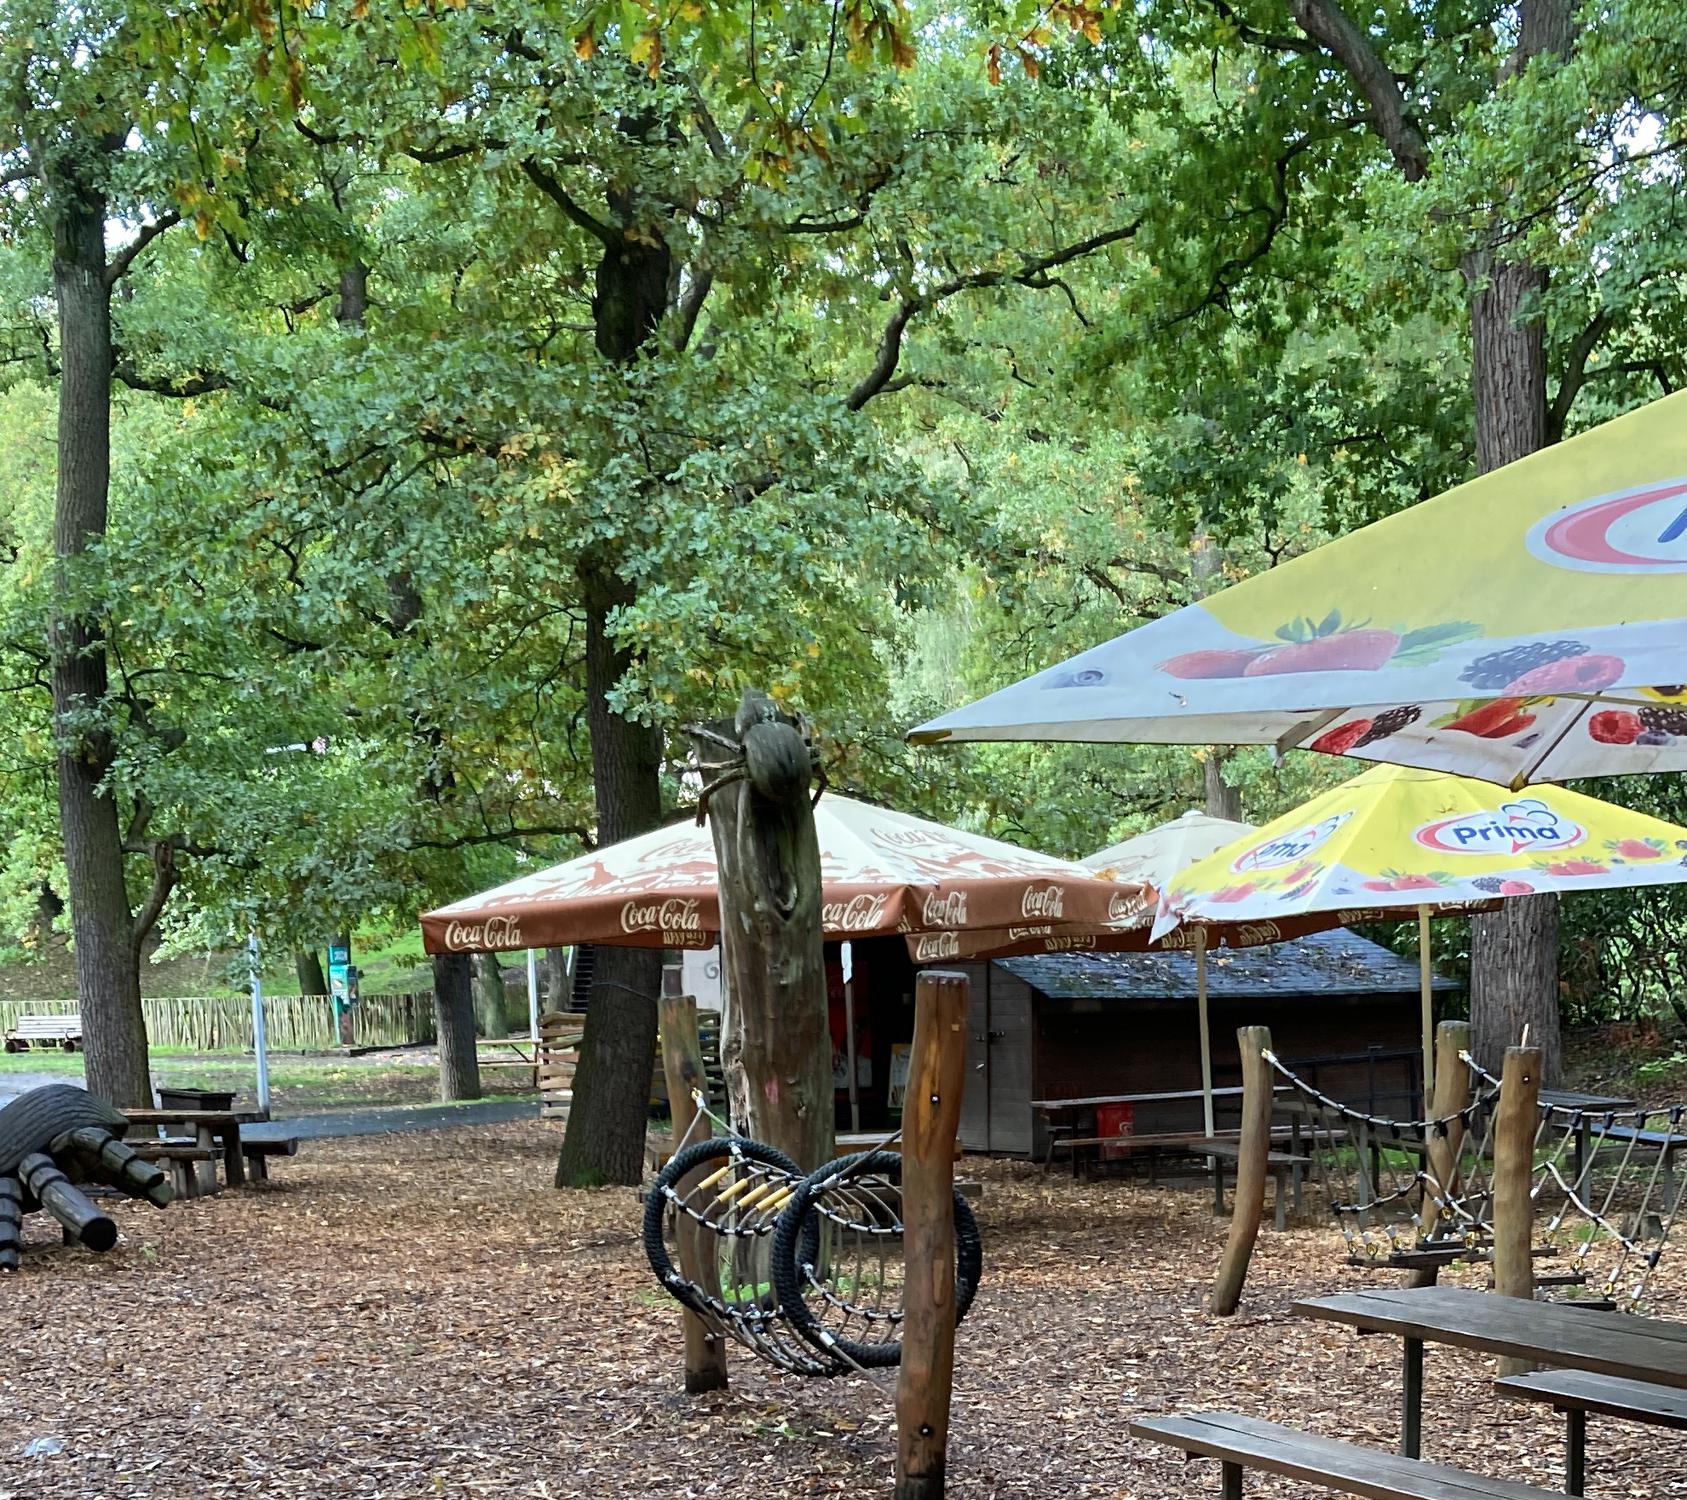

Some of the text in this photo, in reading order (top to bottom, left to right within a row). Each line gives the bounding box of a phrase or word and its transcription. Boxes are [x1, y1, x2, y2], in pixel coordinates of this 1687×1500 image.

[1452, 820, 1561, 845] Prima
[620, 898, 702, 934] Coca-Cola
[822, 893, 889, 932] ca-Cola
[922, 890, 968, 926] Coca-Cola
[1021, 885, 1065, 918] Coca-Cola
[444, 914, 522, 951] Coca-Cola
[915, 931, 961, 961] Coca-Cola
